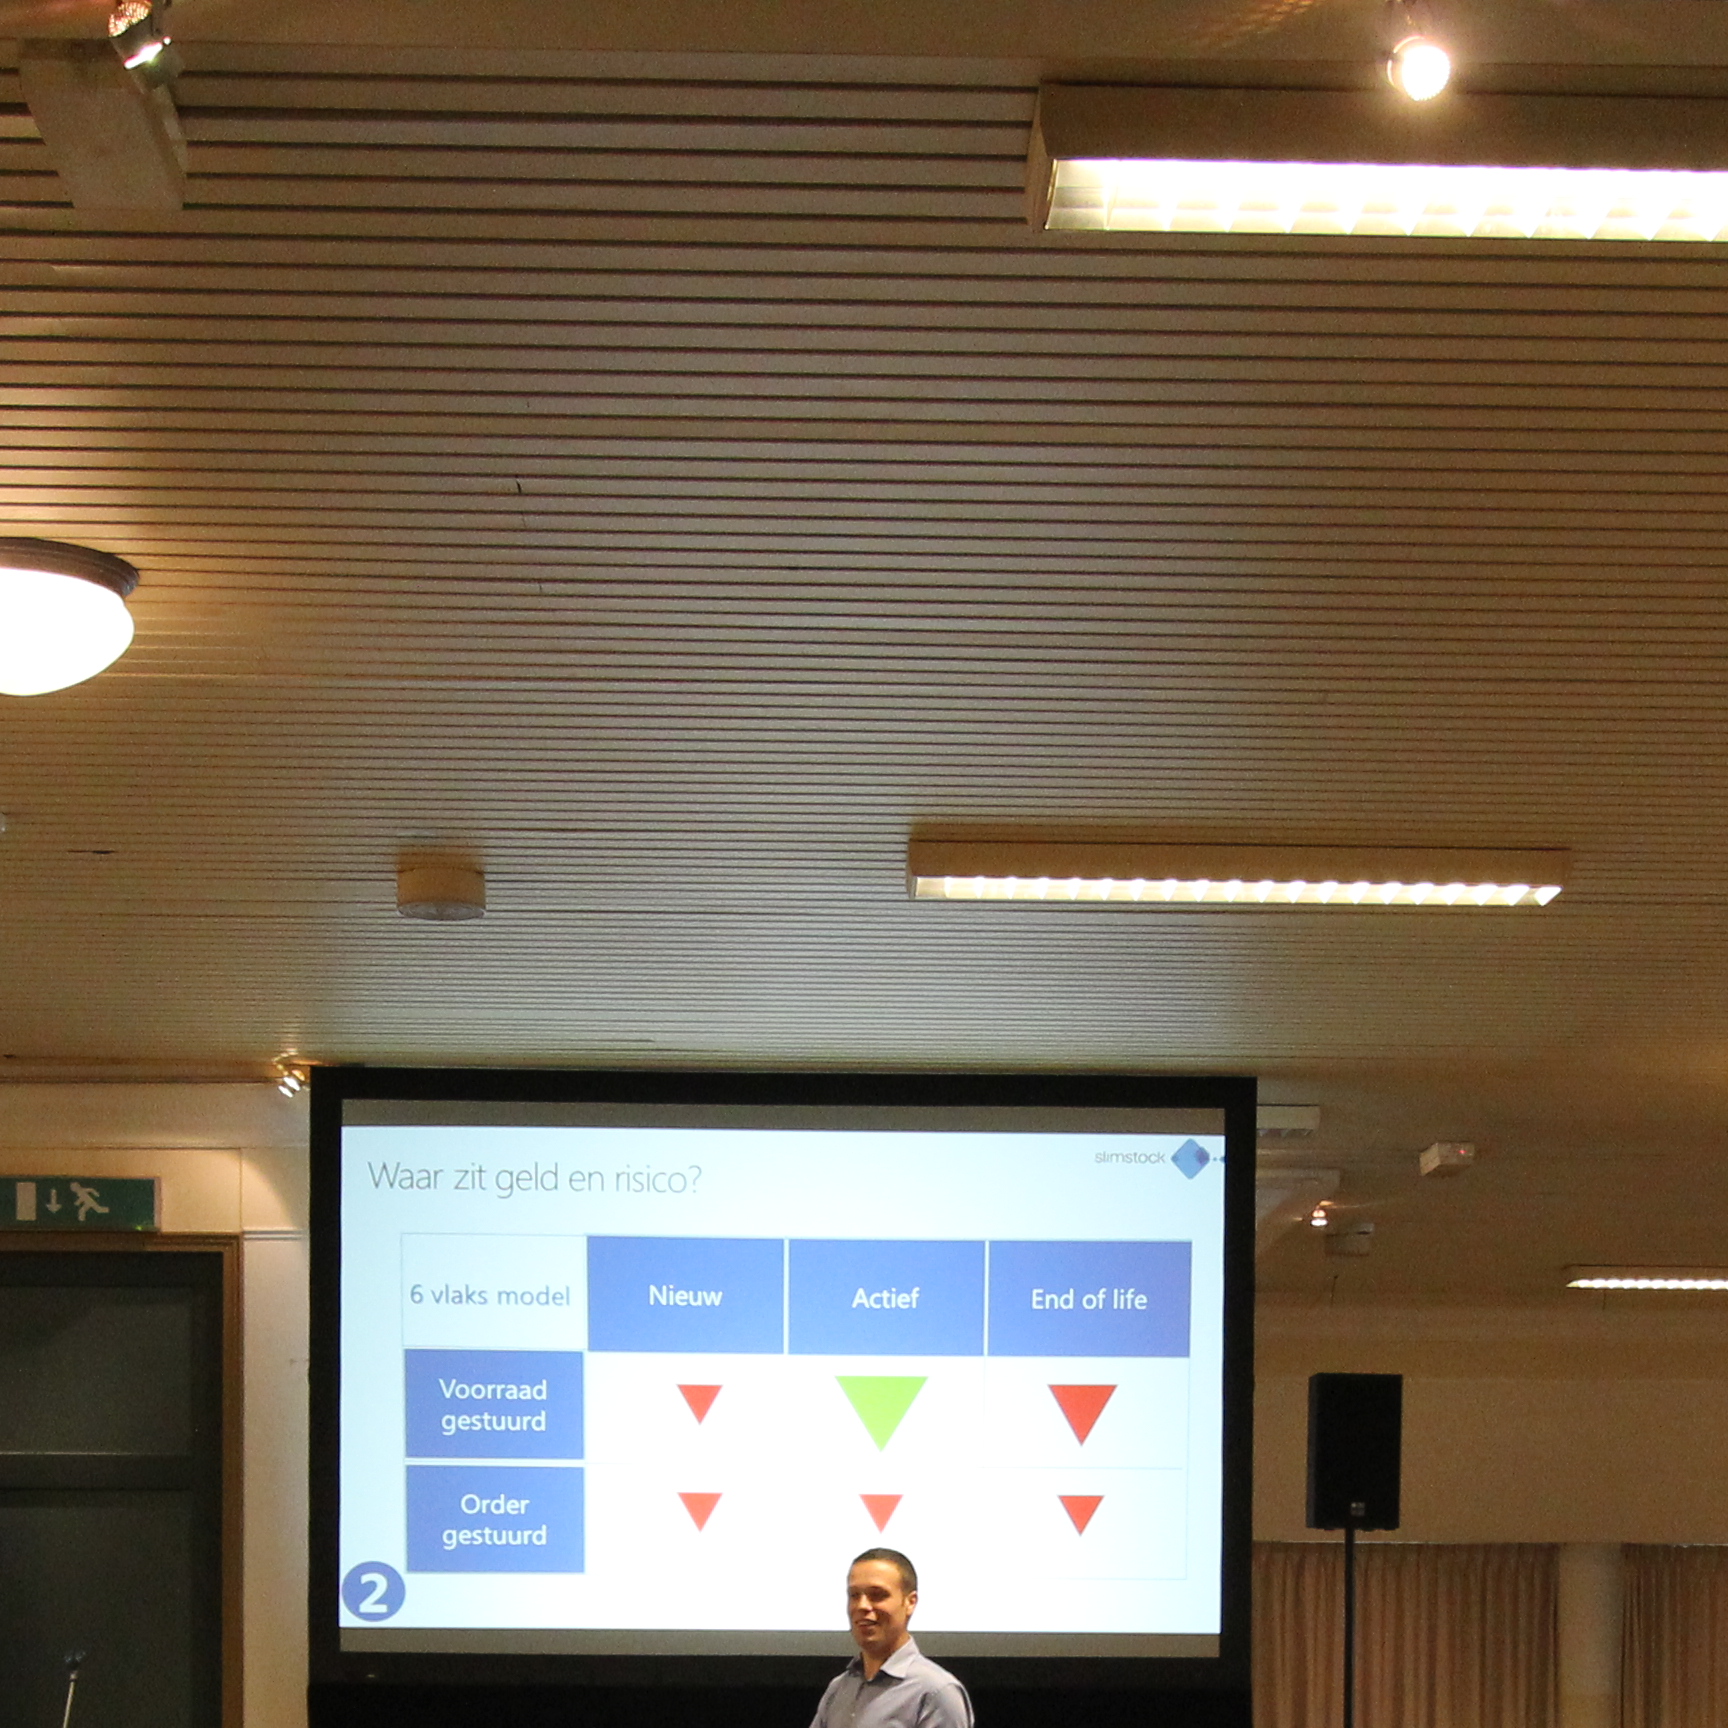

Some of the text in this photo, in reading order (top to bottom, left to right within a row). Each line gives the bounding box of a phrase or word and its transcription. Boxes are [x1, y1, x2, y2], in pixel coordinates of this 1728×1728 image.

[1094, 1150, 1167, 1165] slimstock
[367, 1161, 703, 1200] Waar zit geld en risico?
[409, 1283, 570, 1307] 6 vlaks model
[649, 1284, 723, 1307] Nieuw
[851, 1286, 920, 1310] Actief
[1031, 1287, 1148, 1310] End of life
[438, 1378, 548, 1401] Voorraad
[441, 1409, 547, 1436] gestuurd
[460, 1493, 531, 1516] Order
[442, 1523, 548, 1551] gestuurd
[358, 1572, 388, 1614] 2
